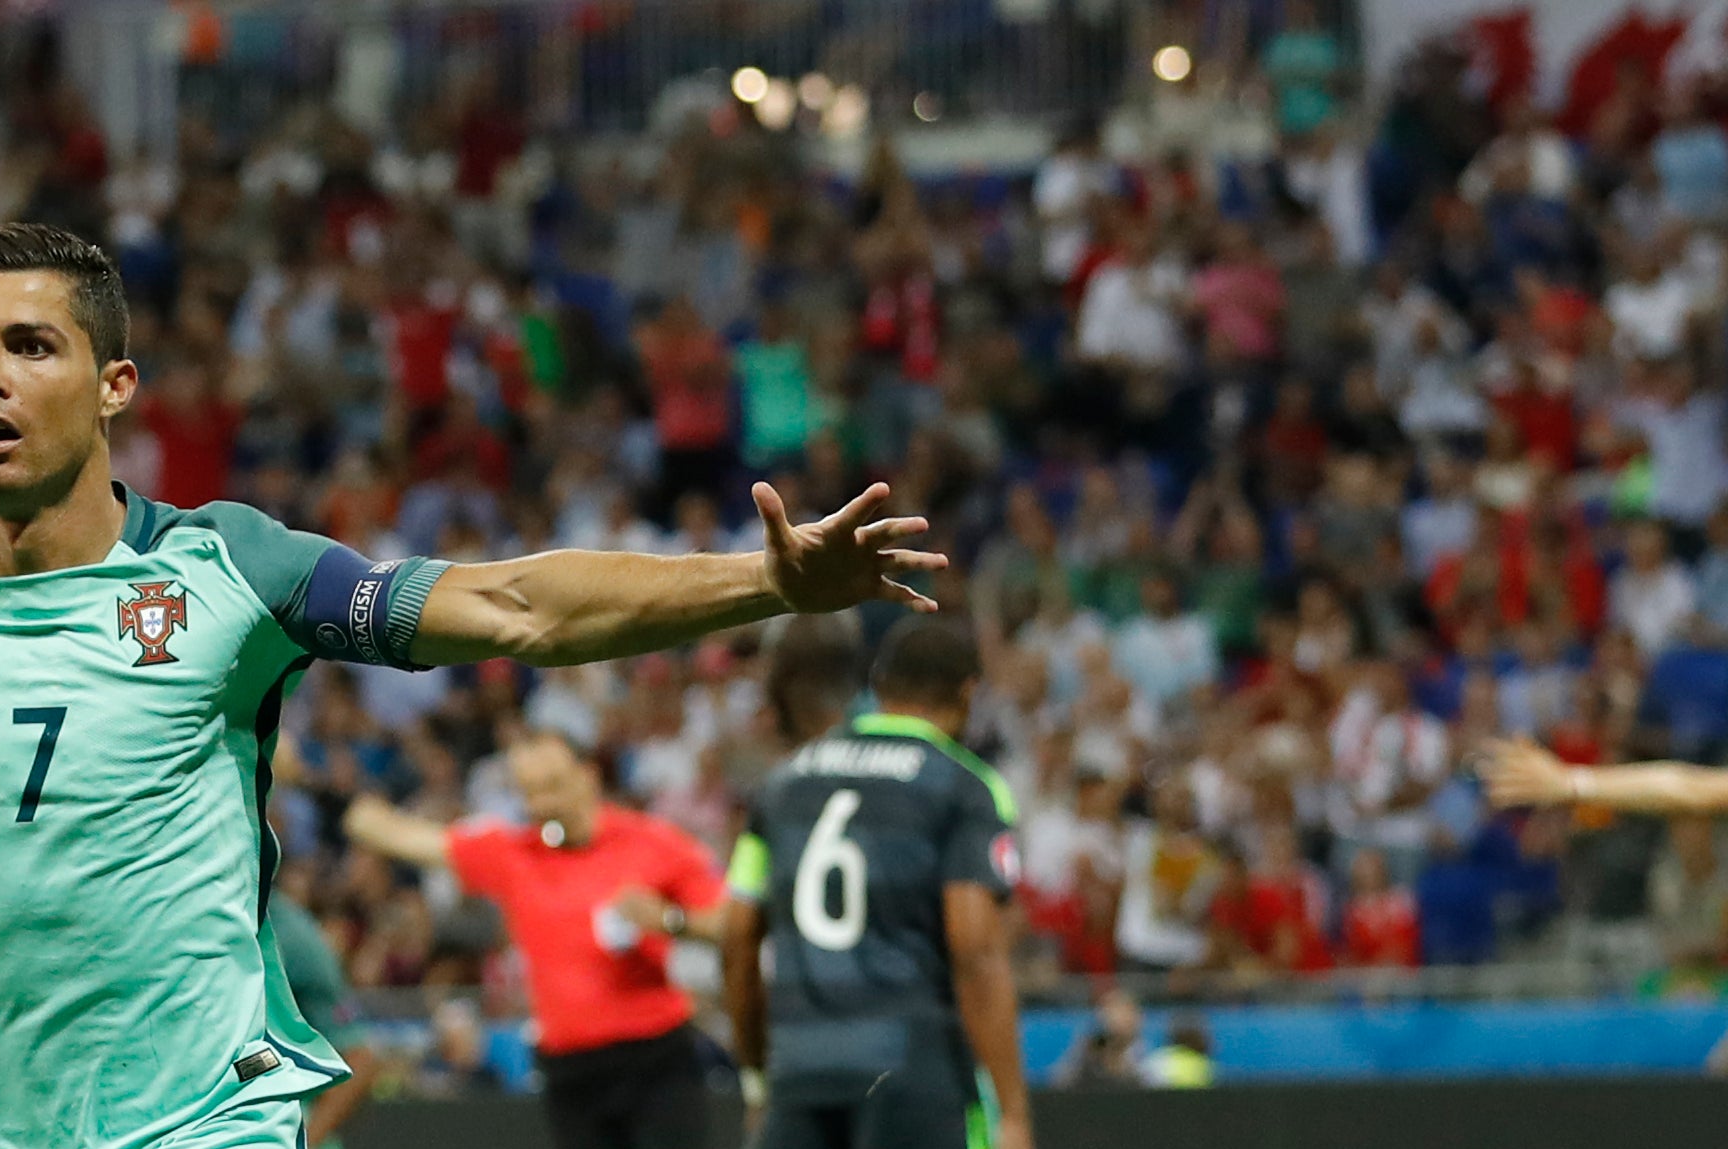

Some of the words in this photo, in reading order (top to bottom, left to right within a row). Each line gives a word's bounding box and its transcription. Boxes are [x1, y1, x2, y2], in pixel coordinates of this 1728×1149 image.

[354, 580, 378, 645] RACISM
[13, 706, 68, 822] 7
[793, 788, 868, 950] 6
